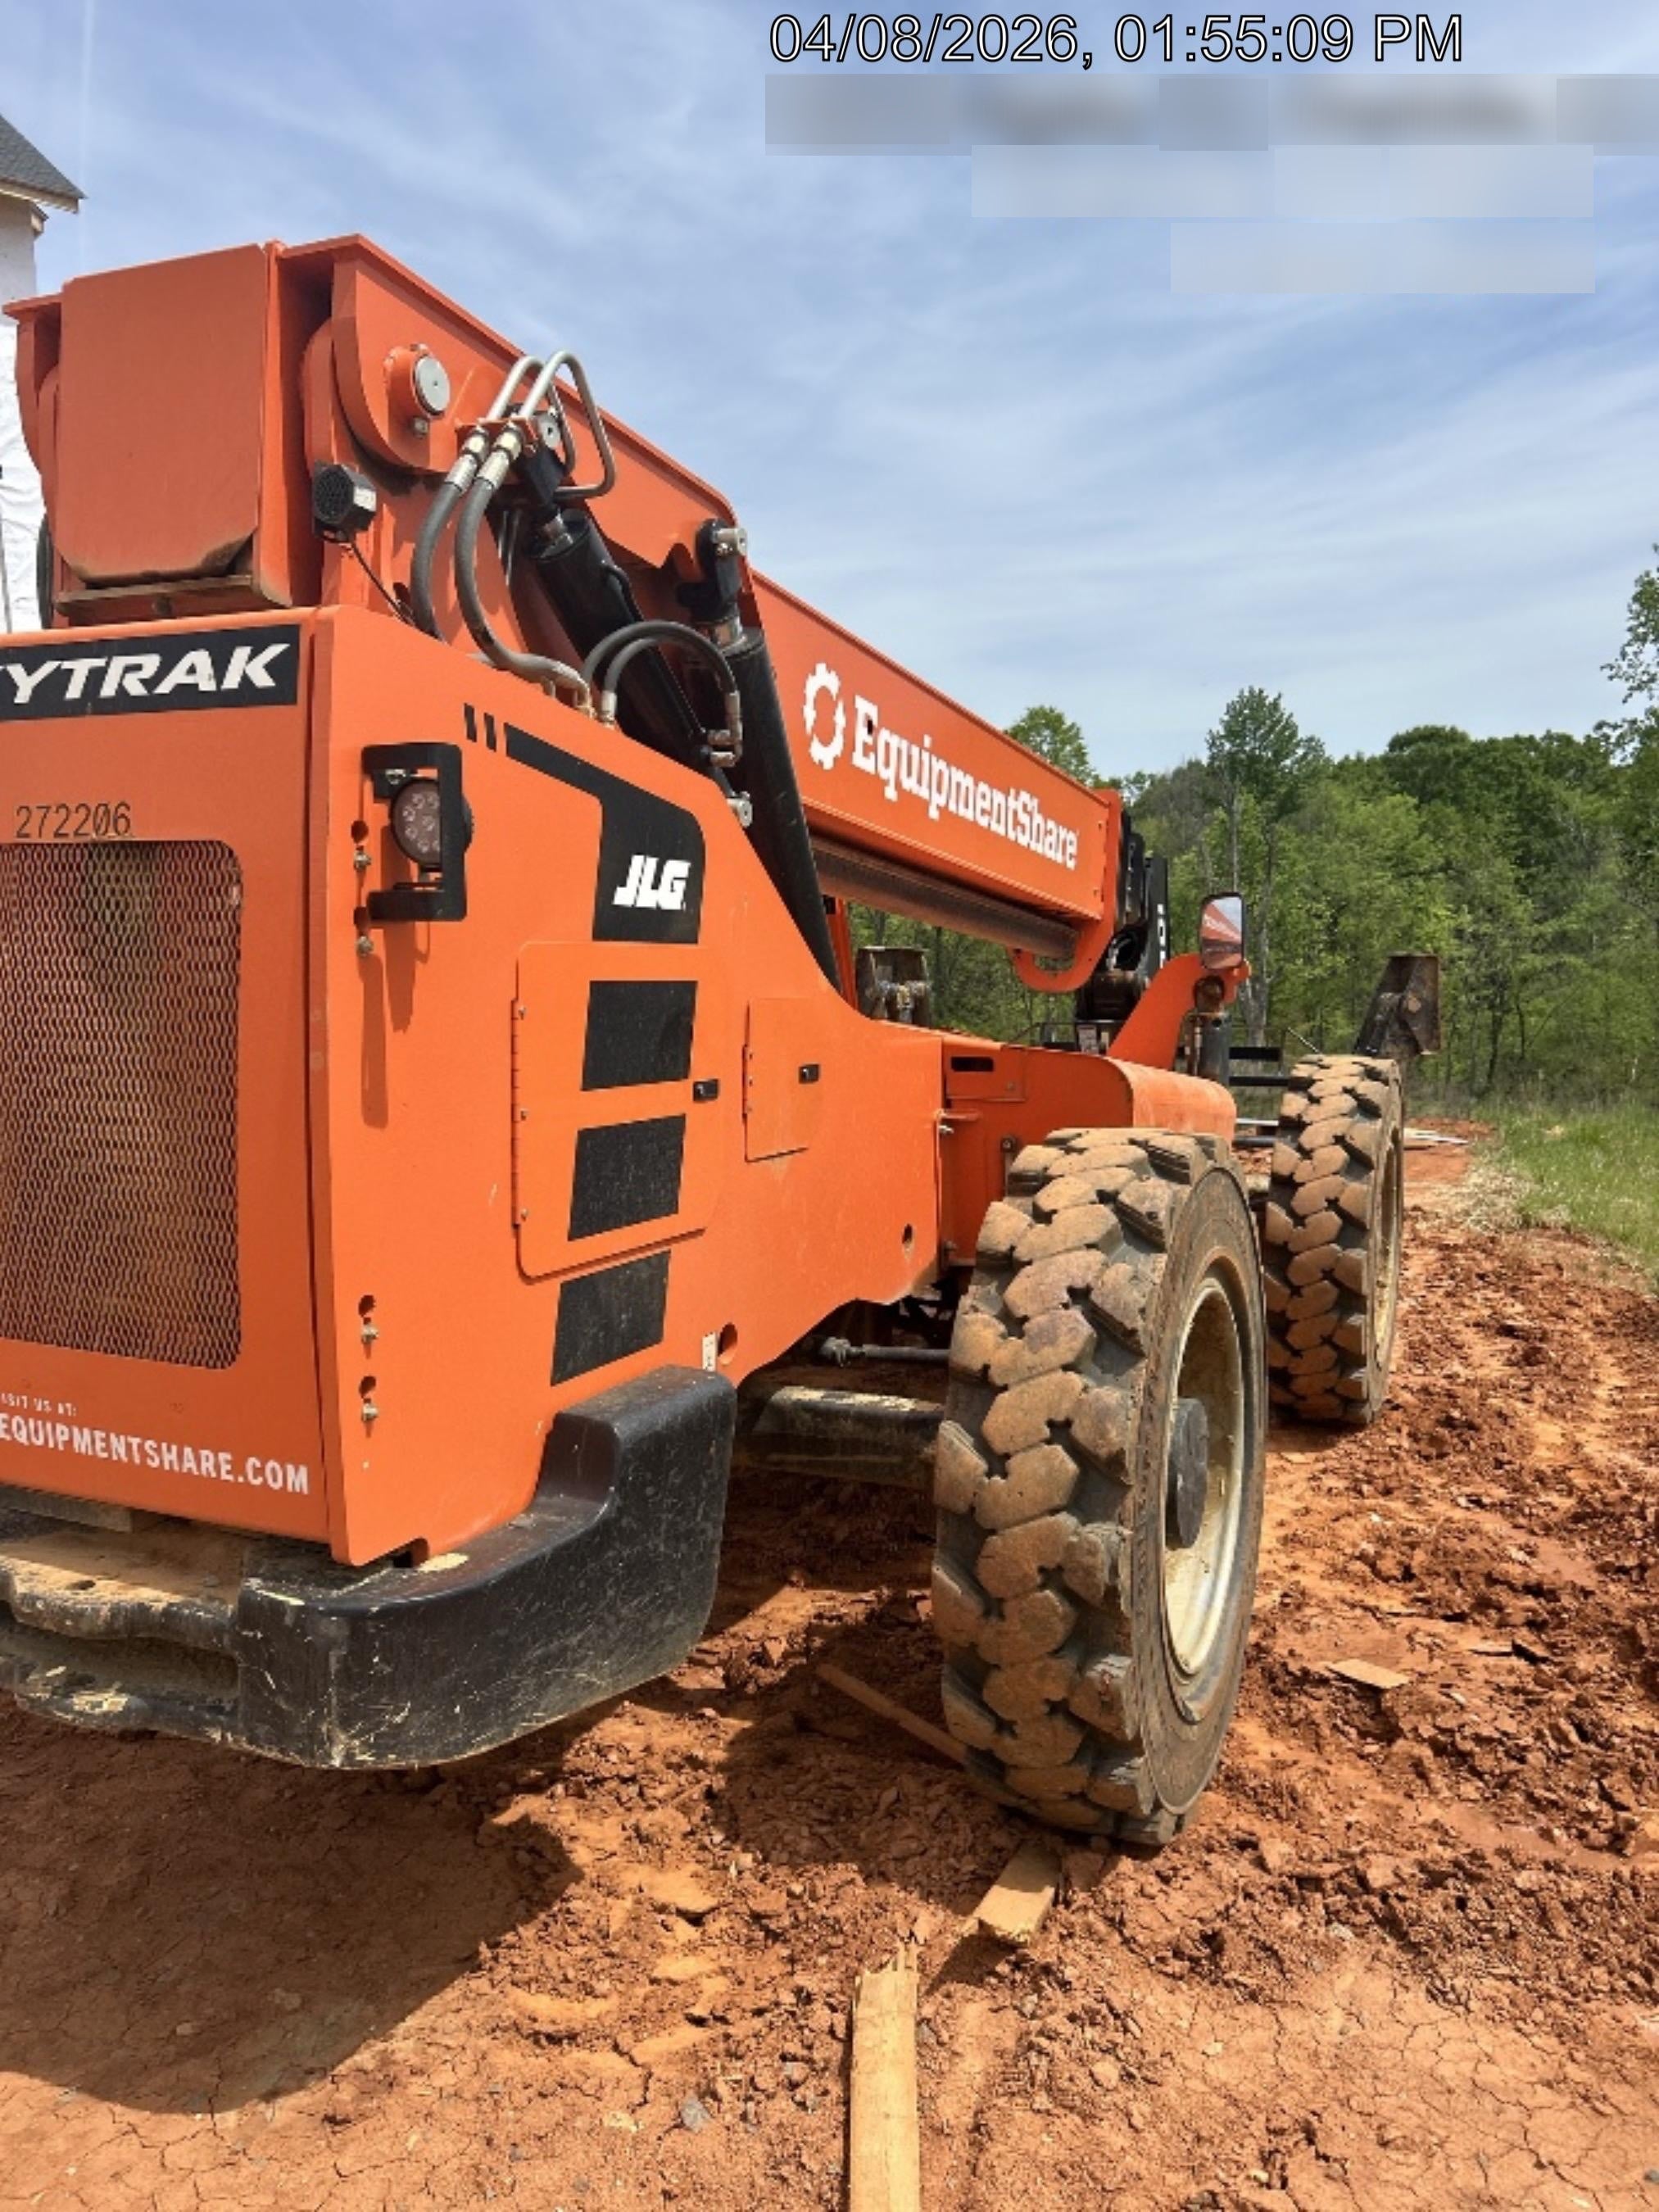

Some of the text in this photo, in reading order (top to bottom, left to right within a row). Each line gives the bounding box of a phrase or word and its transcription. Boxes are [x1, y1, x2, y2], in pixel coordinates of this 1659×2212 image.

[0, 643, 291, 704] YTRAK
[852, 694, 1078, 870] EquipmentShare
[16, 801, 131, 838] 272206
[612, 854, 691, 910] JLG
[1, 1393, 28, 1409] ISIT
[33, 1398, 52, 1412] US
[0, 1412, 309, 1495] EQUIPMENTSHARE.COM
